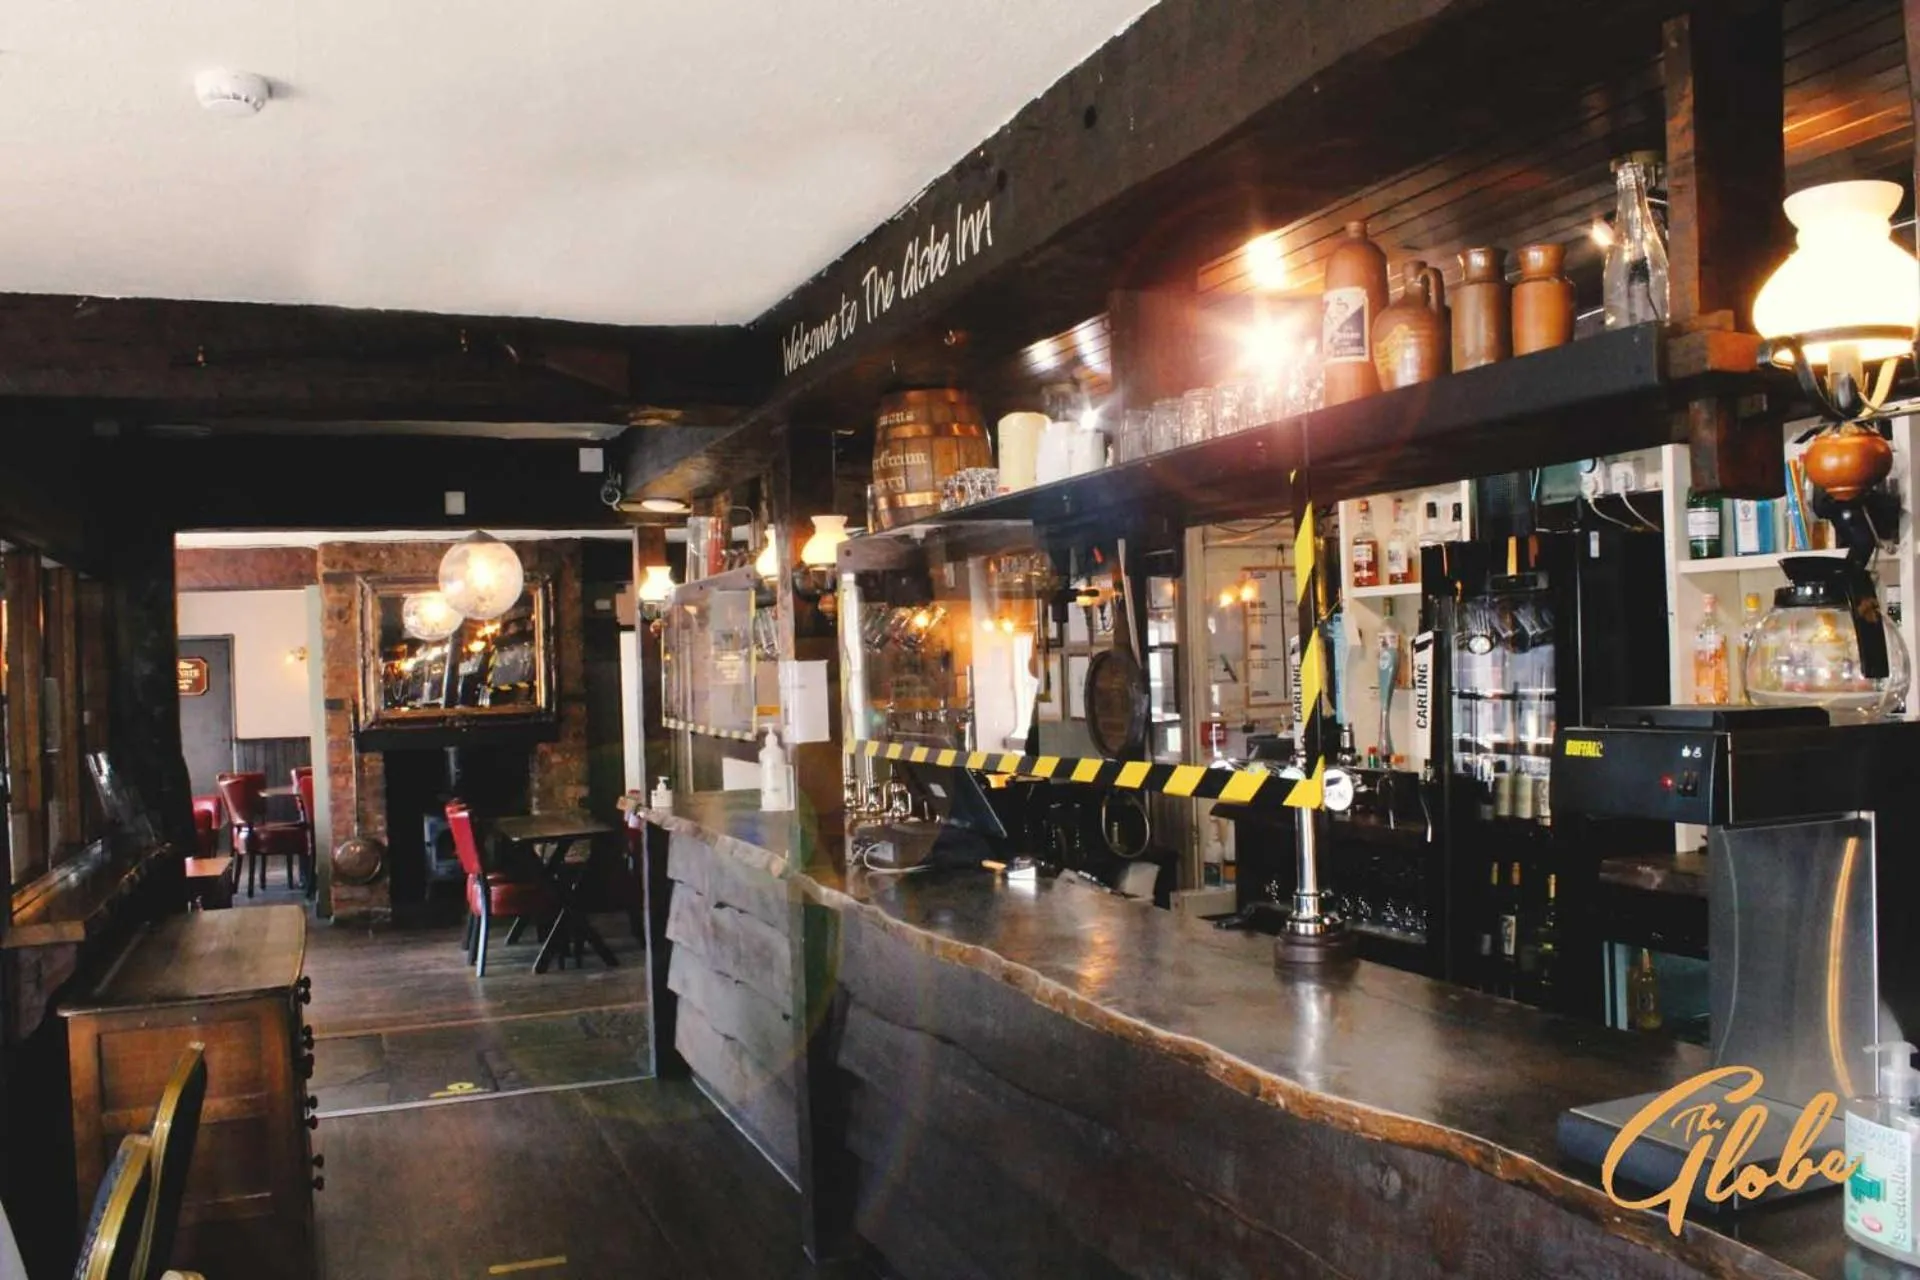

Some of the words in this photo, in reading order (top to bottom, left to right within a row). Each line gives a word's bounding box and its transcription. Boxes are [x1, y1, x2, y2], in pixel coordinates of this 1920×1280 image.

[782, 314, 837, 376] Welcome
[839, 292, 857, 341] to
[861, 265, 895, 324] The
[901, 223, 951, 300] Globe
[956, 200, 992, 266] Inn
[1416, 663, 1428, 729] CARLING
